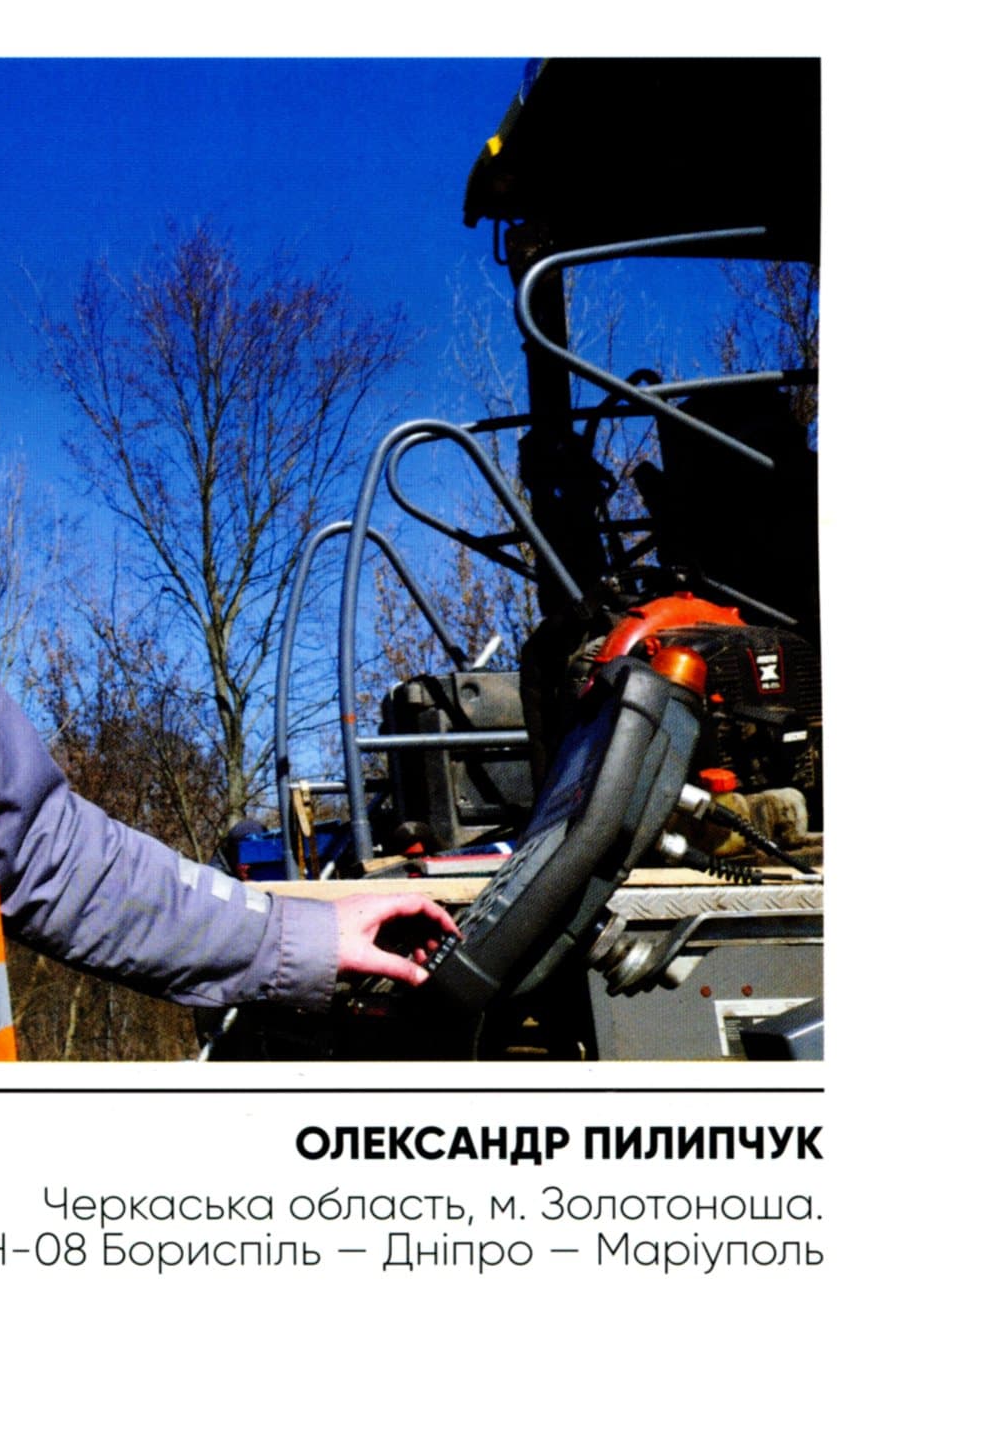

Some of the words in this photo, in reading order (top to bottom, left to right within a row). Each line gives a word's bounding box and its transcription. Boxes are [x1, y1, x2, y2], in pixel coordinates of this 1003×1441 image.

[296, 1126, 569, 1165] ОЛЕКСАНДР
[585, 1126, 823, 1159] ПИЛИПЧУК
[45, 1187, 272, 1228] Черкаська
[290, 1187, 473, 1225] область,
[492, 1196, 525, 1219] м.
[542, 1186, 822, 1220] Золотоноша.
[102, 1232, 320, 1274] Бориспіль
[383, 1233, 532, 1274] Дніпро
[598, 1233, 823, 1274] Маріуполь
